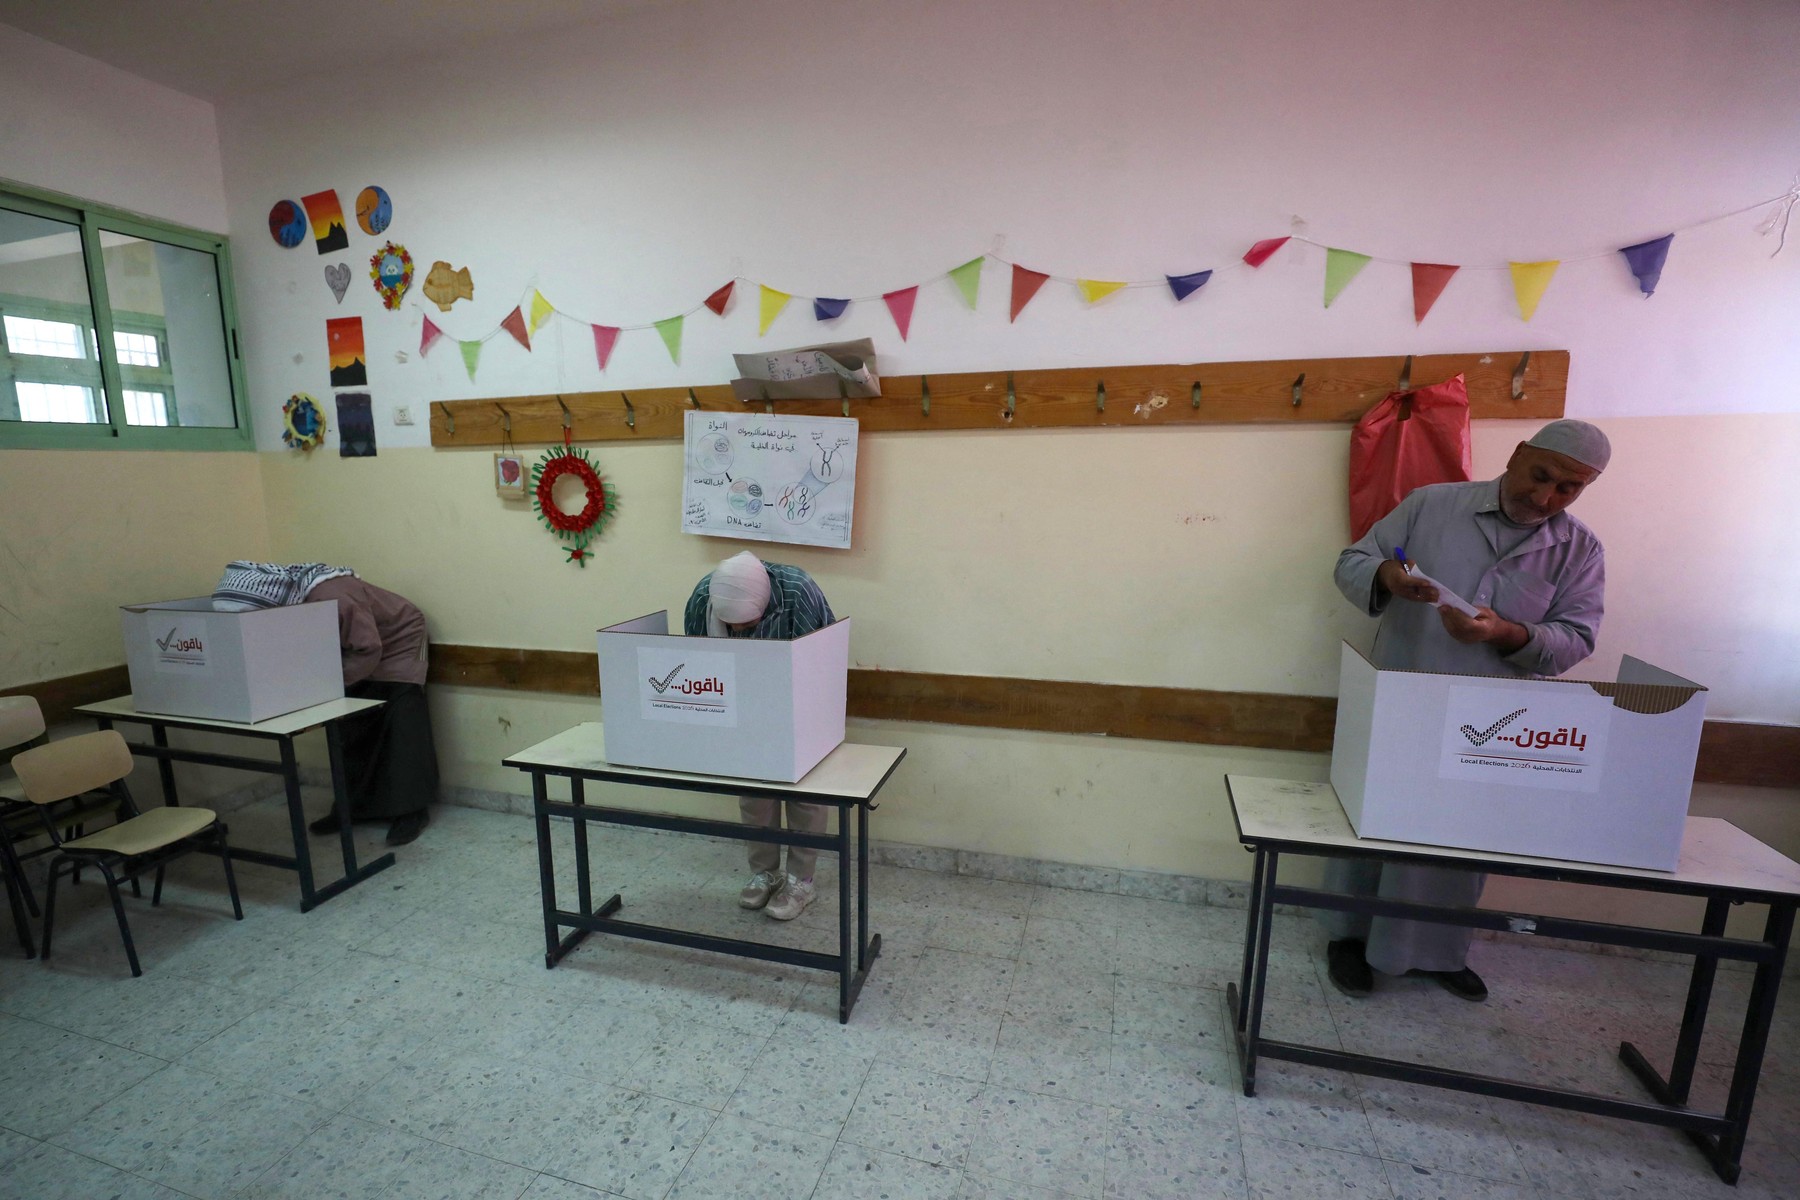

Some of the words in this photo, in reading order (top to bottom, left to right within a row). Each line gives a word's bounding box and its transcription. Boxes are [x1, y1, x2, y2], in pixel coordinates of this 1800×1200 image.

[709, 420, 728, 431] النواة
[776, 429, 797, 440] مراحل
[726, 515, 742, 526] DNA
[1460, 757, 1478, 765] Local
[1478, 759, 1509, 768] Elections
